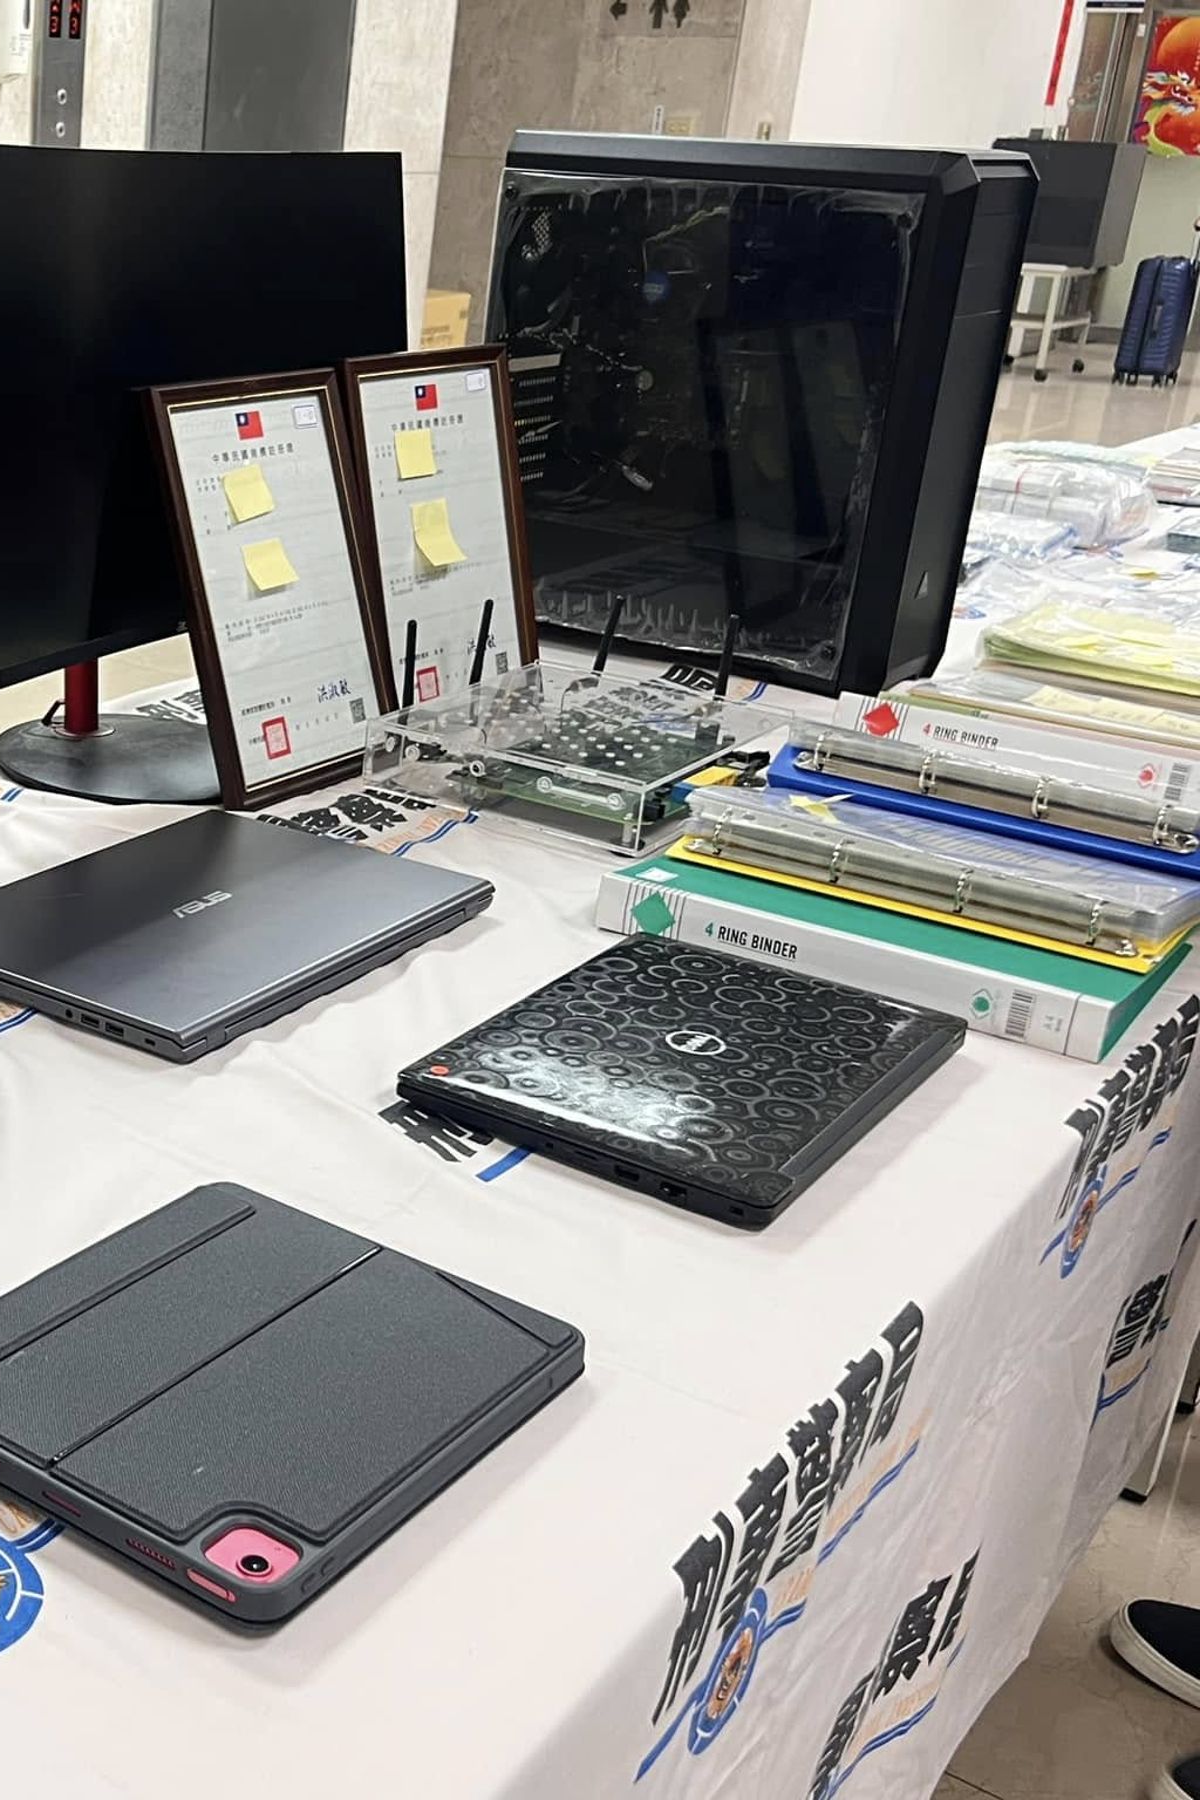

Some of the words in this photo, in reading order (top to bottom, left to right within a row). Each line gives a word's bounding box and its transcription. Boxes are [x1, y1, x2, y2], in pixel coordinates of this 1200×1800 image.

[922, 723, 931, 737] 4
[934, 726, 959, 742] RING
[961, 732, 999, 749] BINDER
[173, 890, 233, 919] ASUS
[705, 922, 714, 937] 4
[718, 926, 748, 946] RING
[751, 934, 798, 960] BINDER
